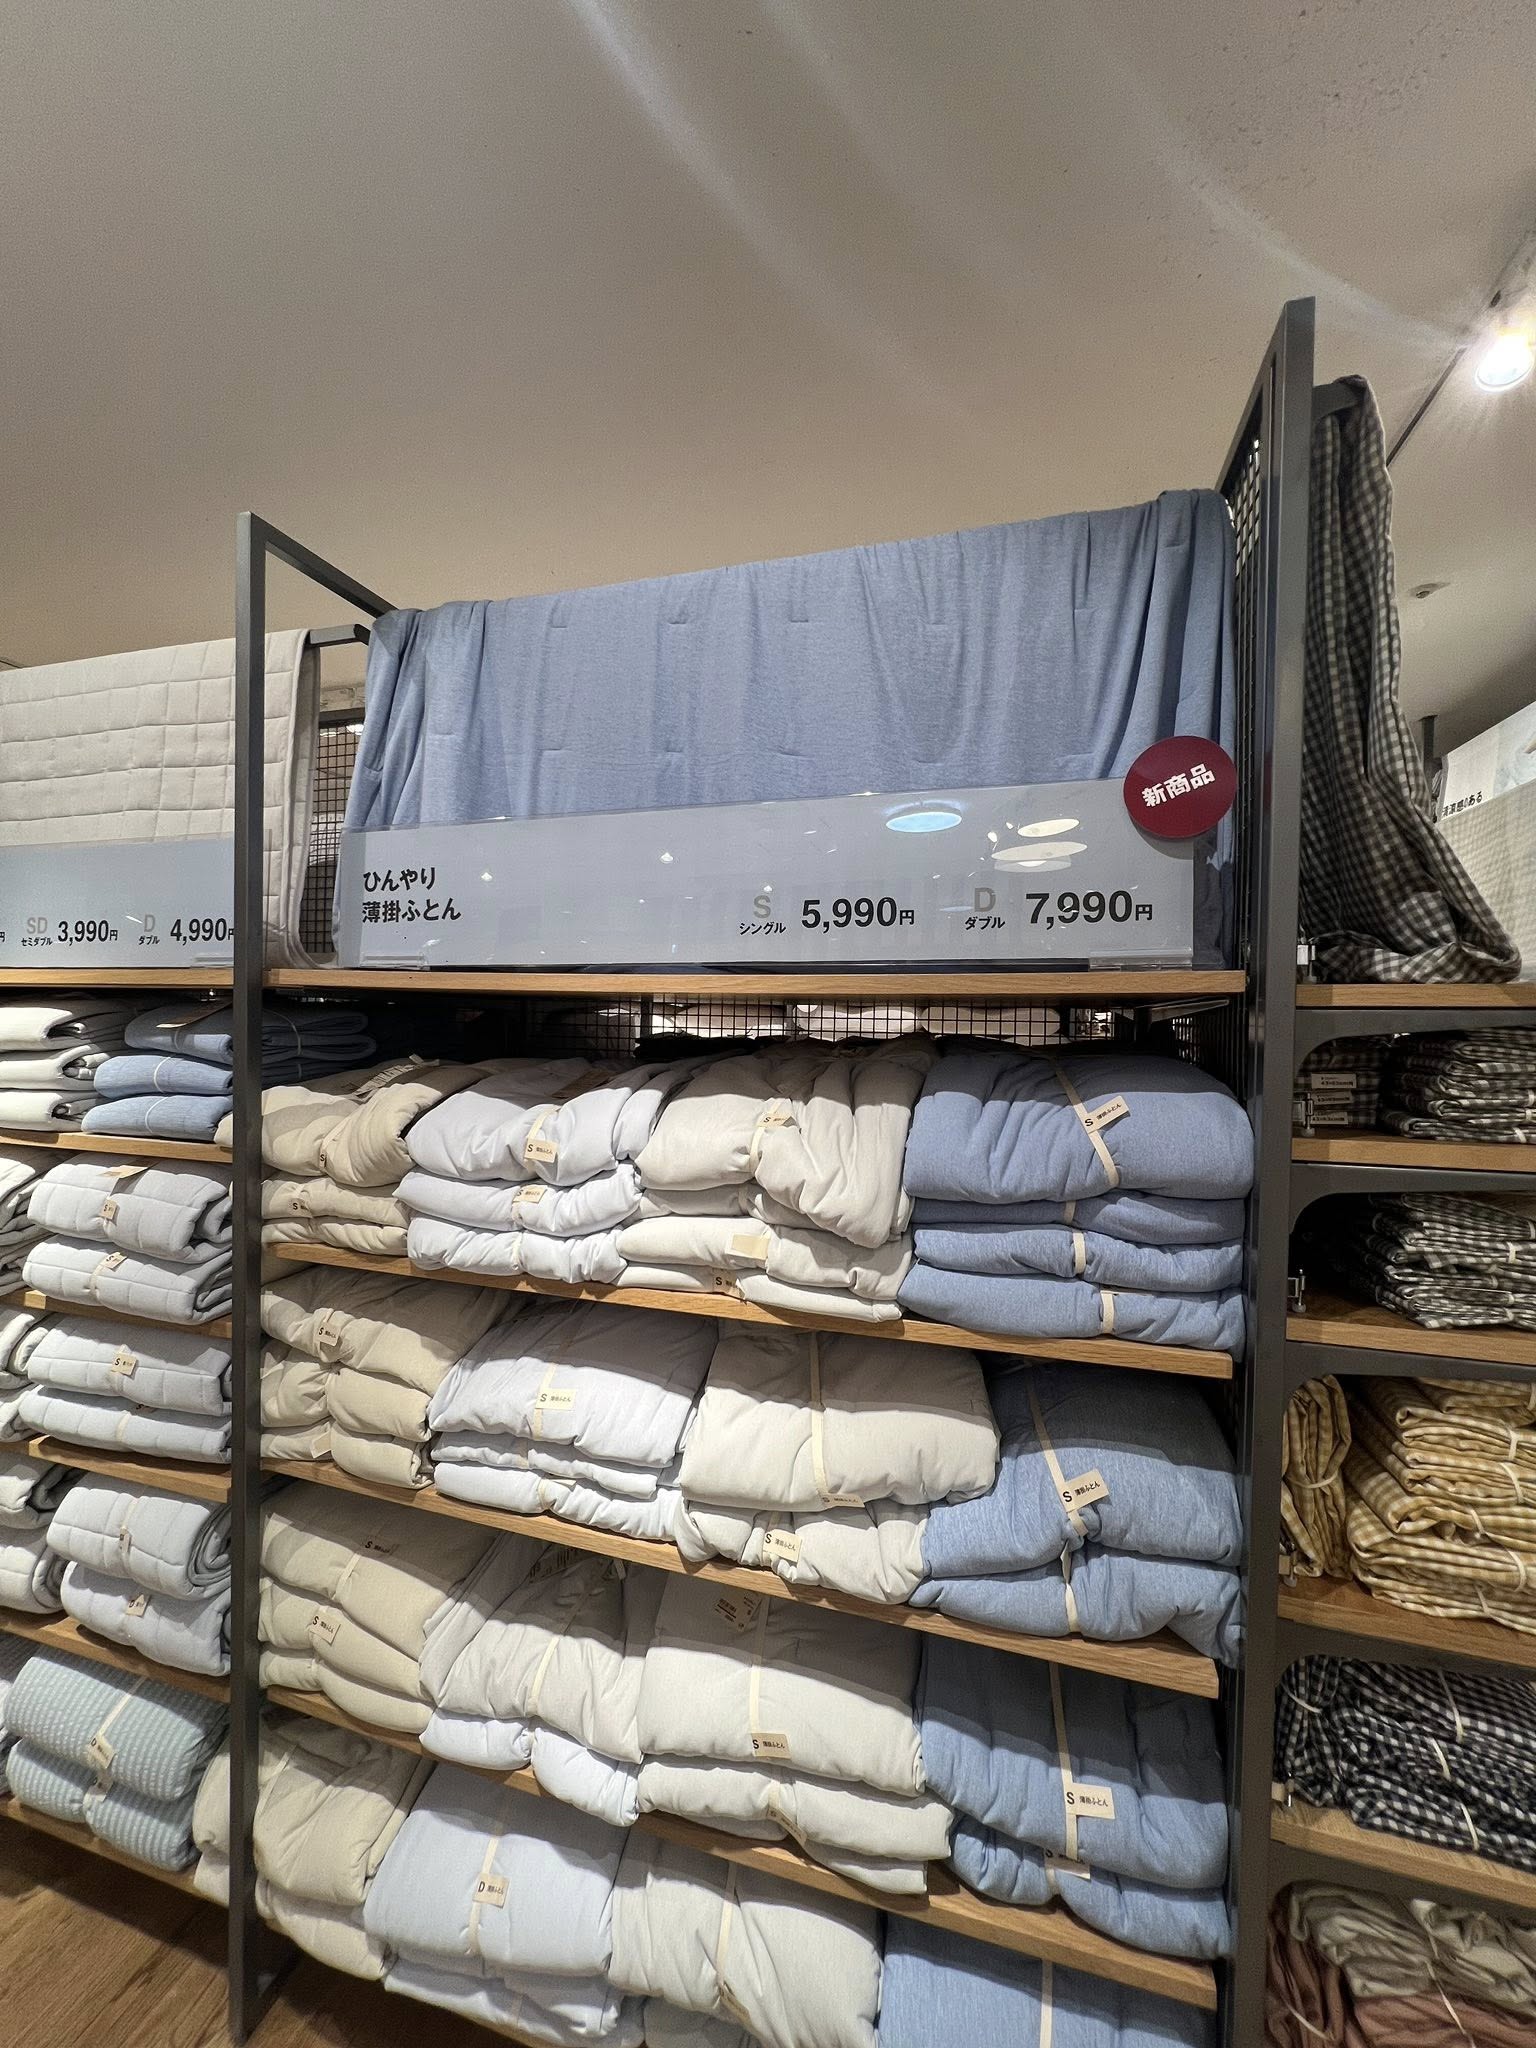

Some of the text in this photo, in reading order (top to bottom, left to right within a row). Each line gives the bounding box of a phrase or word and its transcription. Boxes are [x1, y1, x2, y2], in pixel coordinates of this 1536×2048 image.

[1141, 763, 1216, 807] 新商品
[363, 867, 436, 893] ひんやり
[974, 887, 997, 913] D
[362, 898, 462, 923] 薄掛ふとん
[753, 895, 771, 919] S
[964, 890, 1153, 931] ダブル 7,990円
[739, 897, 915, 936] シングル 5,990円
[26, 917, 48, 934] SD
[143, 914, 156, 932] D
[21, 920, 119, 947] セミダブル 3,990円
[138, 935, 161, 945] ダブル
[1085, 1118, 1094, 1127] S
[527, 1143, 534, 1153] S
[292, 1202, 299, 1211] S
[715, 1276, 722, 1286] S
[318, 1326, 325, 1336] S
[540, 1393, 548, 1403] S
[1062, 1491, 1073, 1503] S
[364, 1540, 373, 1549] S
[765, 1533, 772, 1544] S
[312, 1615, 320, 1626] S
[752, 1739, 760, 1750] S
[1066, 1791, 1075, 1805] S
[477, 1880, 486, 1893] D
